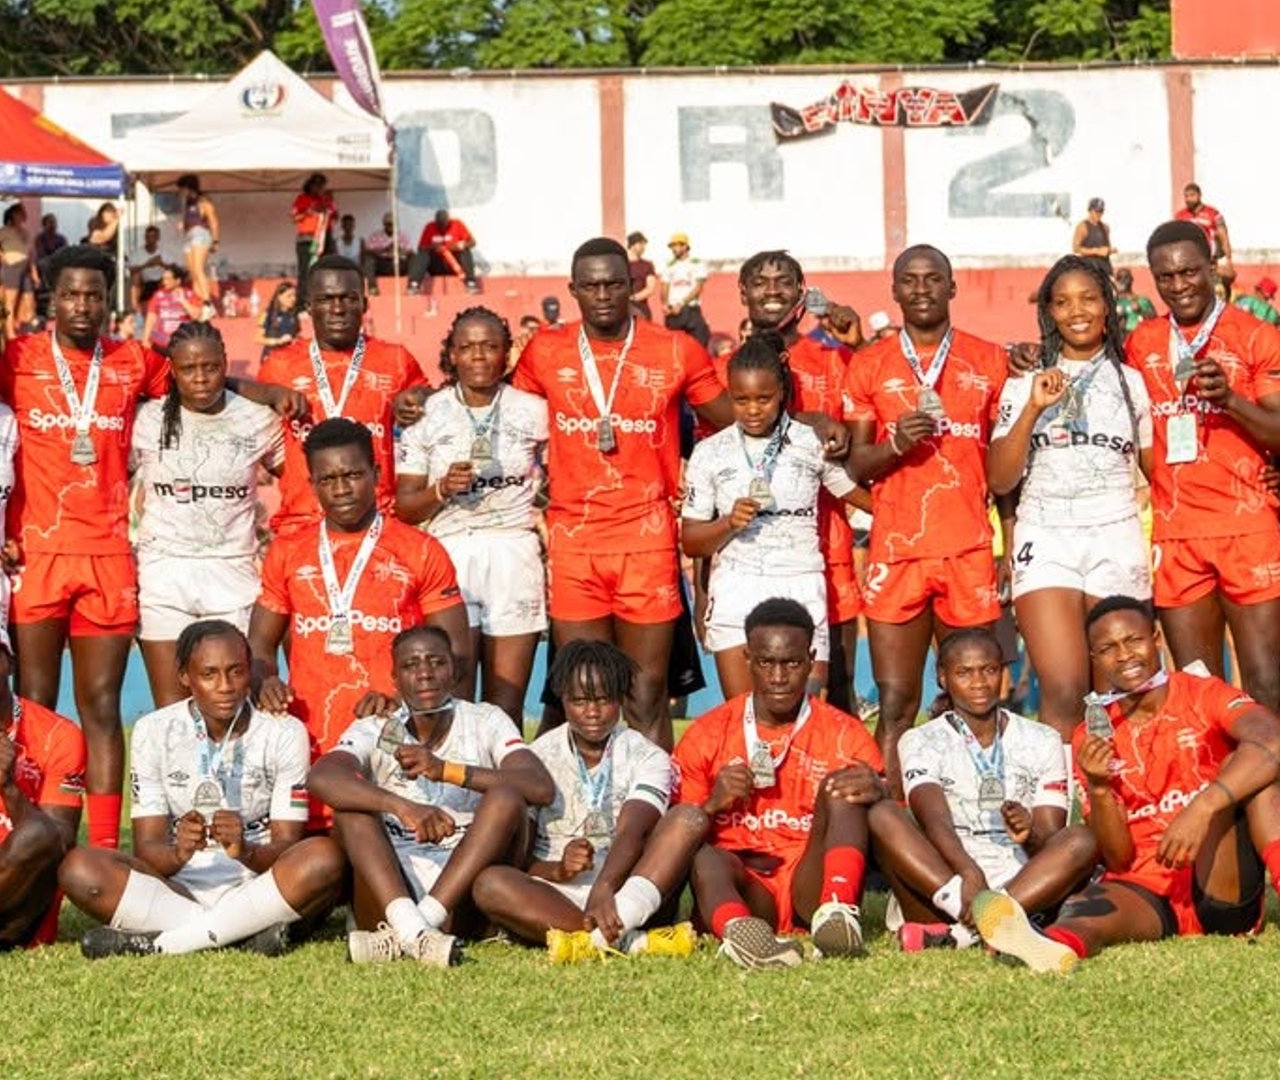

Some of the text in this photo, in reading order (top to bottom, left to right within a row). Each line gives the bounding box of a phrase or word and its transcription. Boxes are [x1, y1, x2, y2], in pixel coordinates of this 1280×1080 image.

[28, 407, 124, 432] SpoPesa
[555, 412, 657, 435] SporPesa
[295, 609, 402, 638] SpoPesa
[716, 808, 813, 832] SportPes
